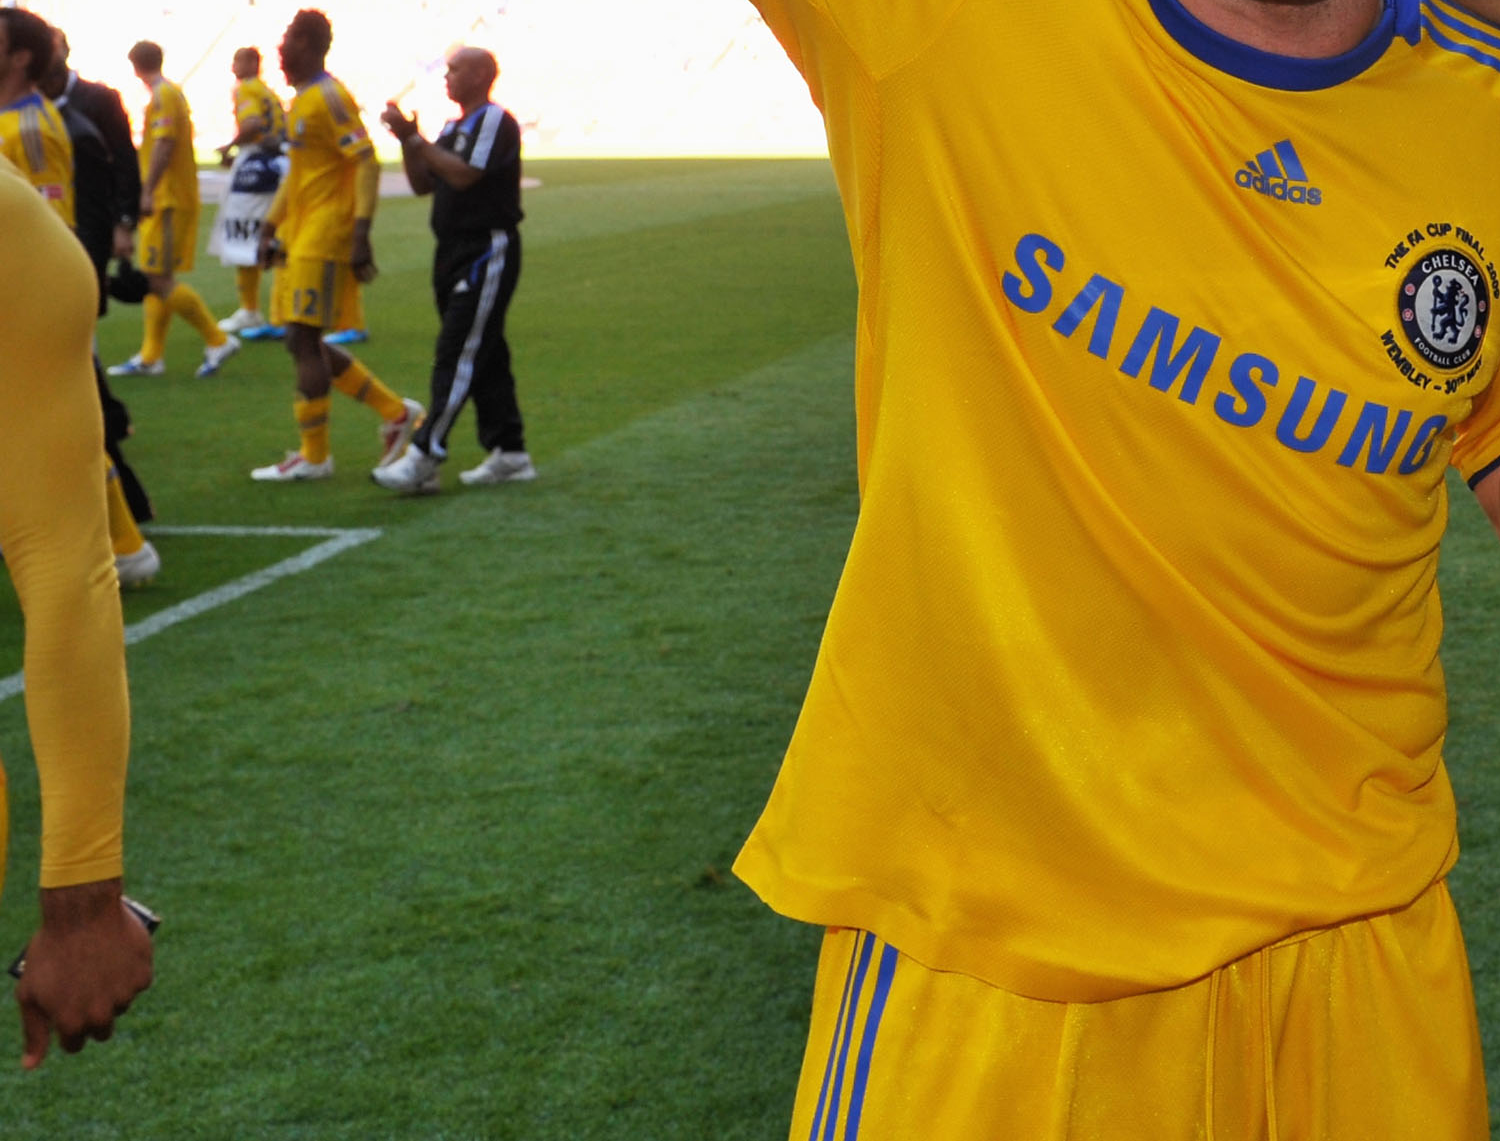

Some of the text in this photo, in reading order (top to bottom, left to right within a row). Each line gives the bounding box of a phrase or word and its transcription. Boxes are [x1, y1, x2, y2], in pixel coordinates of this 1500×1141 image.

[1234, 169, 1322, 206] adidas
[1385, 222, 1500, 299] THE FA CUP FINAL 2009
[1421, 254, 1479, 287] CHELSEA
[1001, 232, 1447, 475] SAMSUNG
[1380, 329, 1432, 390] WEMBLEY
[1414, 337, 1471, 365] FOOTBALL CLUB
